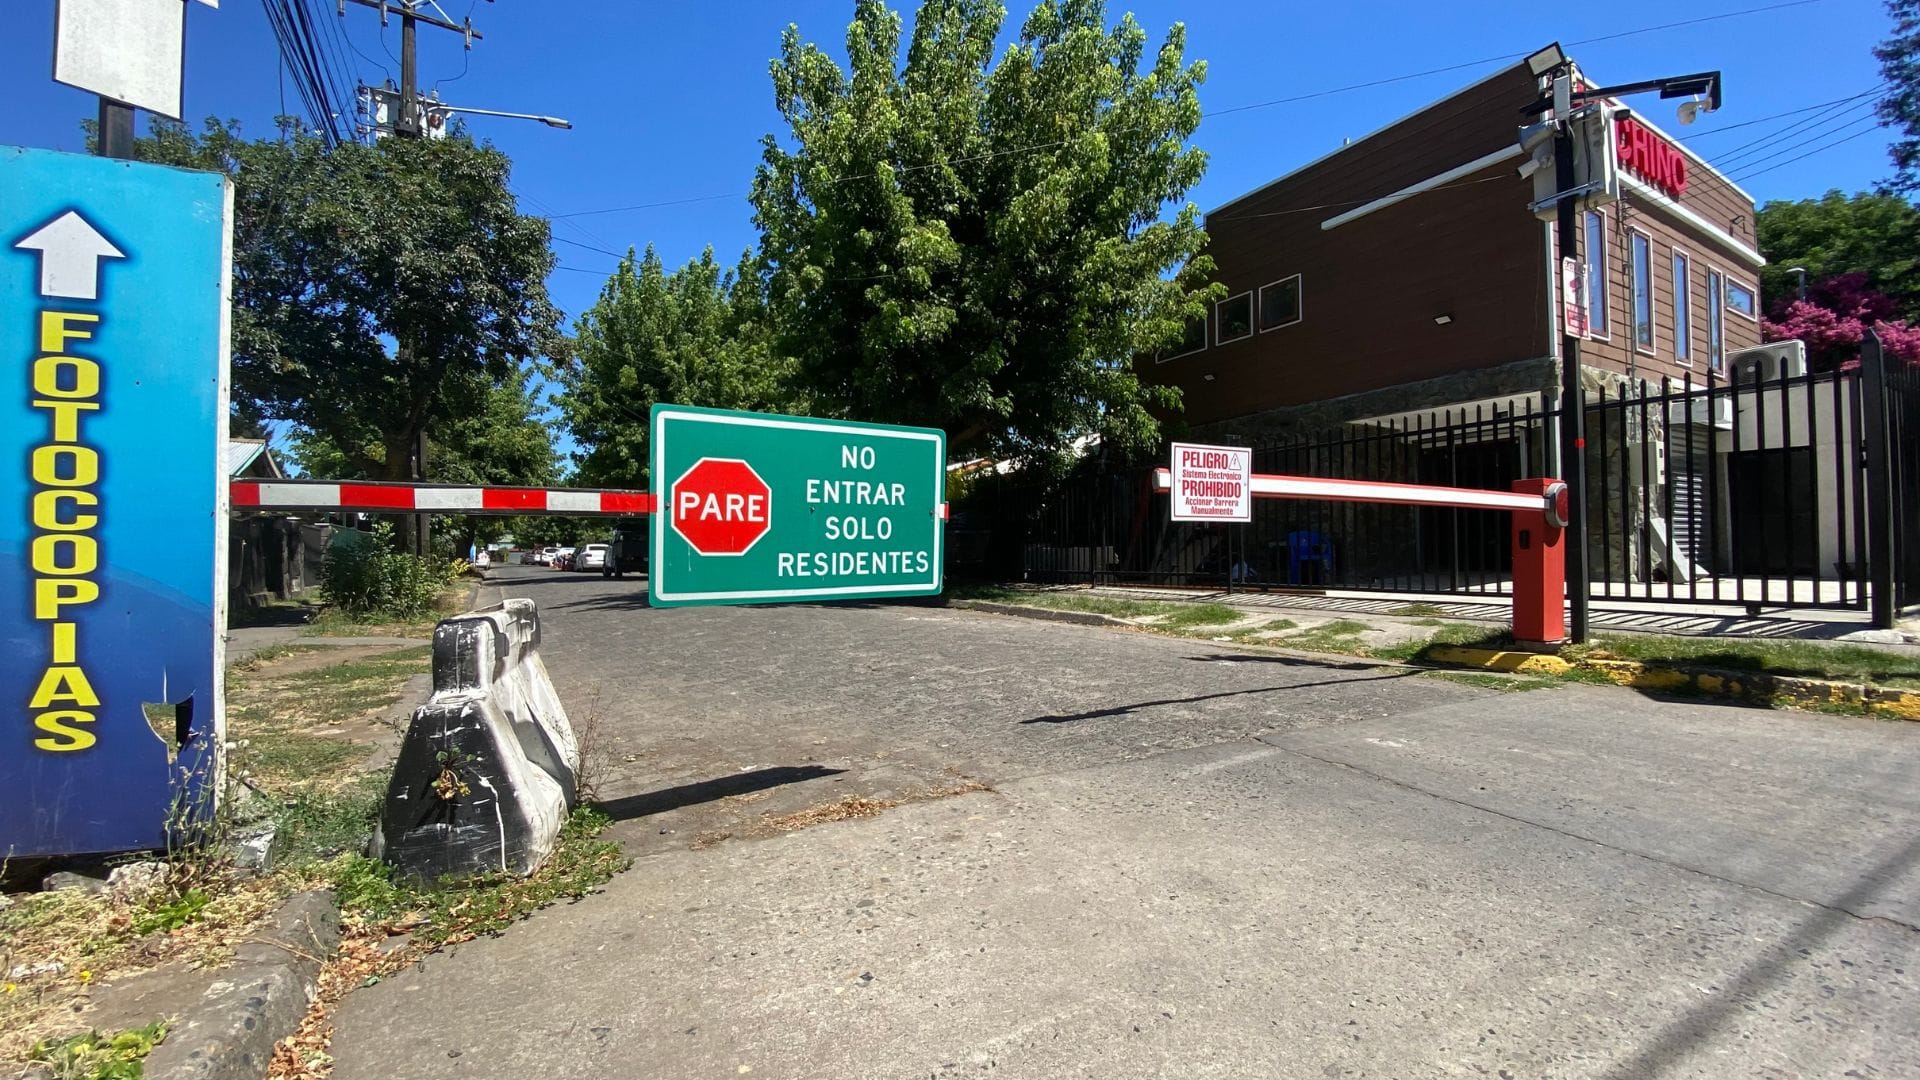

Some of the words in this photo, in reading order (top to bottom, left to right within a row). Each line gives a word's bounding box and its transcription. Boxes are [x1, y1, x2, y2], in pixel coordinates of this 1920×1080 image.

[1615, 118, 1687, 193] CHINO
[841, 445, 876, 471] NO
[1183, 451, 1228, 469] PELIGRO
[1182, 469, 1207, 479] Sistema
[806, 479, 905, 506] ENTRAR
[1182, 480, 1241, 498] PROHIBIDO
[680, 491, 765, 522] PARE
[1185, 497, 1213, 507] Accionar
[1214, 498, 1239, 507] Barrera
[1191, 506, 1234, 516] Manualmente
[30, 311, 100, 752] FOTOCOPIAS
[825, 516, 892, 541] SOLO
[778, 551, 930, 577] RESIDENTES
